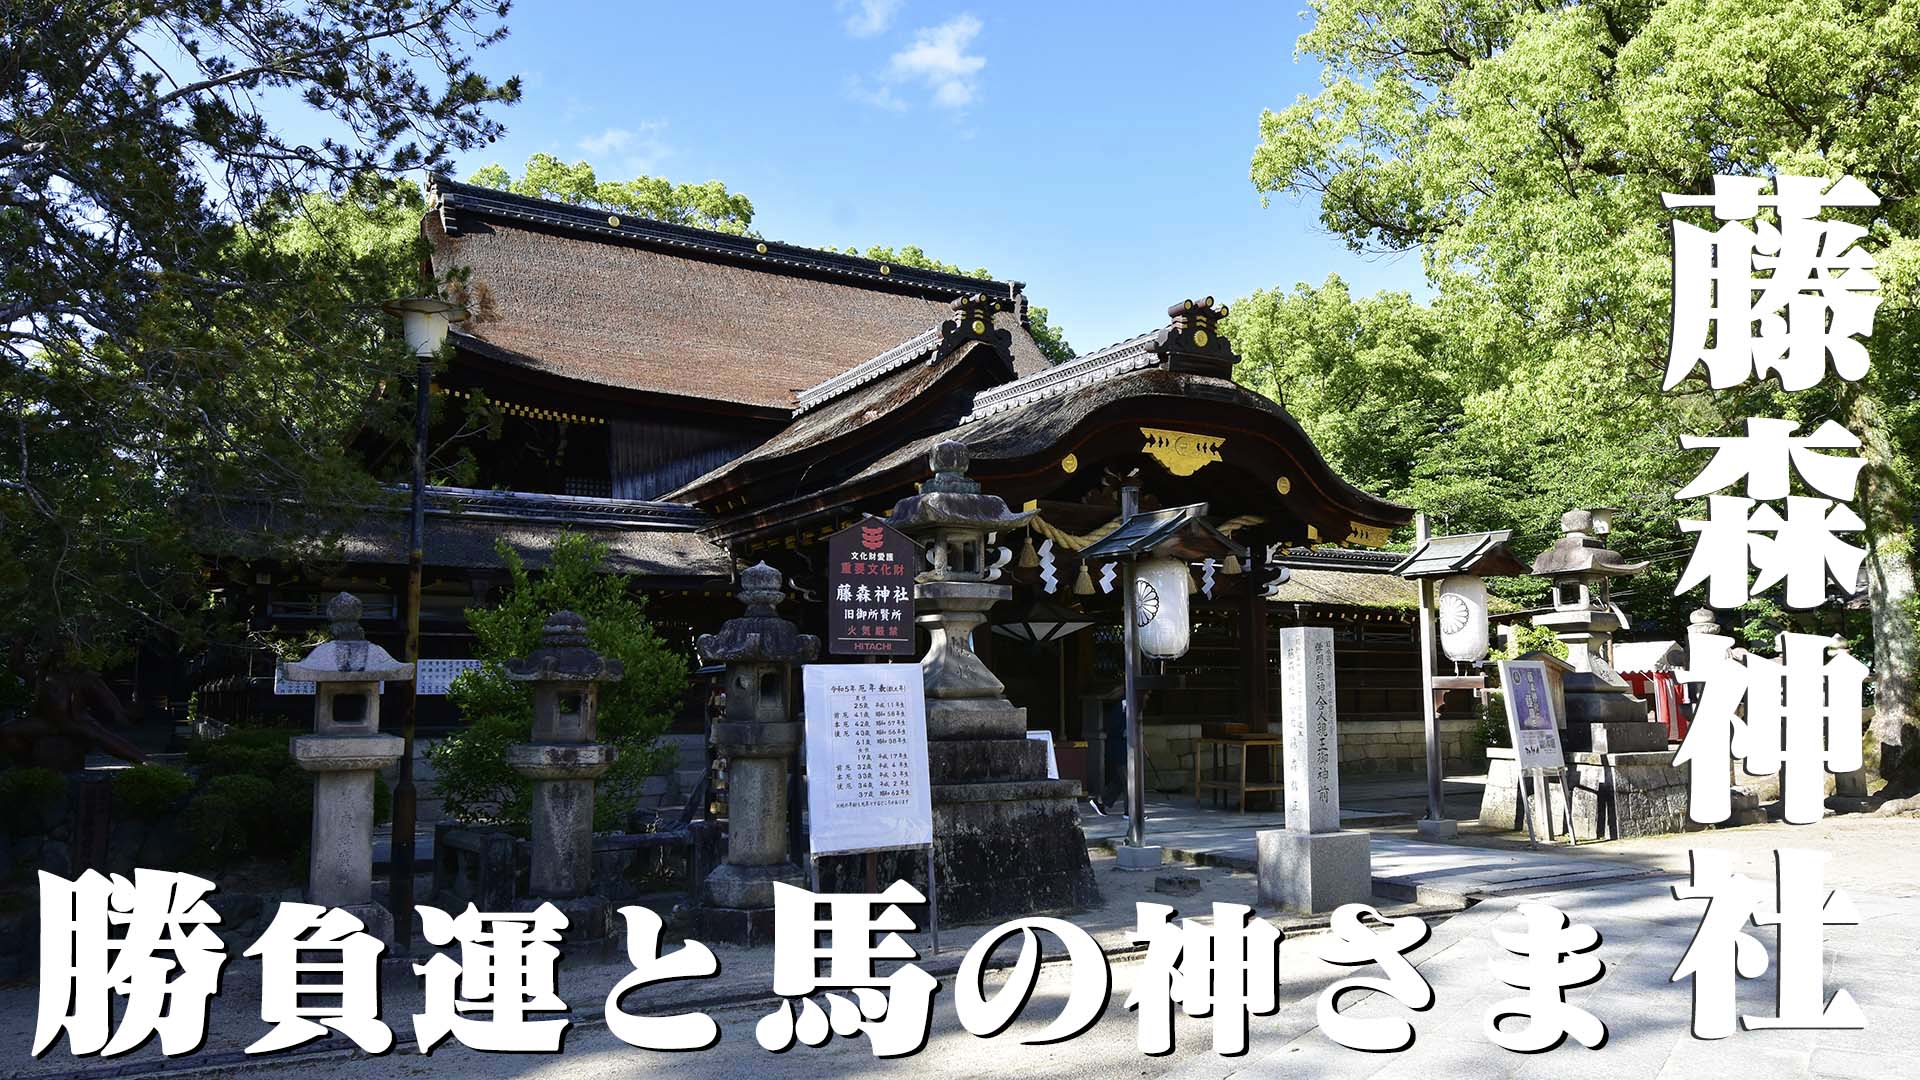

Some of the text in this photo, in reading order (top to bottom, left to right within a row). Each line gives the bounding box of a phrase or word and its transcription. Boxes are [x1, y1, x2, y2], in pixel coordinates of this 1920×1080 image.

[850, 551, 895, 562] 文化財愛護
[841, 562, 905, 576] 重要文化財
[835, 583, 910, 604] 藤森神社
[844, 608, 902, 622] 旧御所賢所
[854, 642, 892, 651] HITACHI
